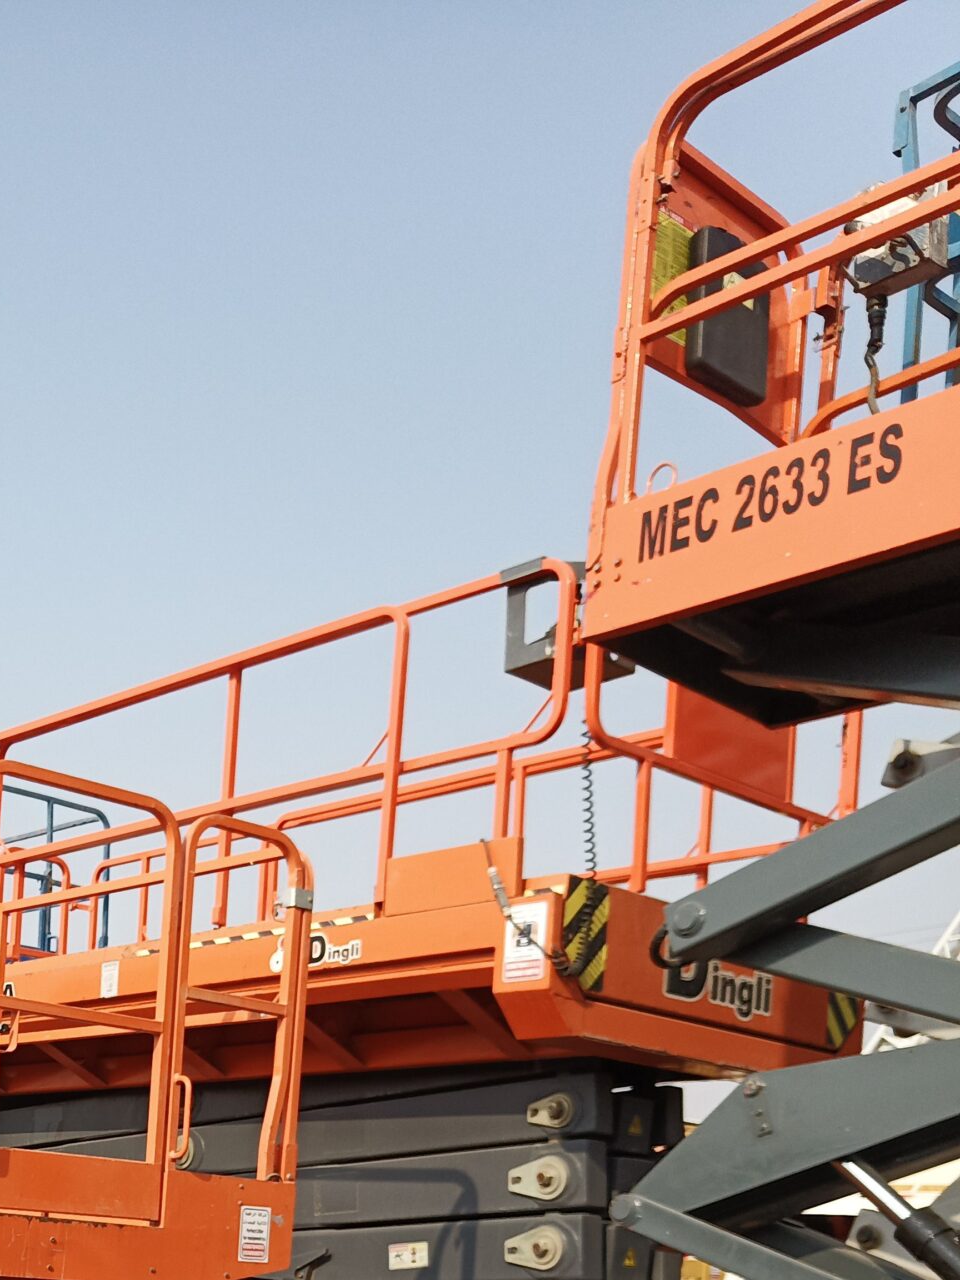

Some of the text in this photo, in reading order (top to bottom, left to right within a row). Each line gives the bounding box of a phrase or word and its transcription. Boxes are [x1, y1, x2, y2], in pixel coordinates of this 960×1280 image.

[638, 423, 903, 563] MEC 2633 ES
[308, 934, 360, 963] Dingli
[665, 958, 771, 1018] Dingli
